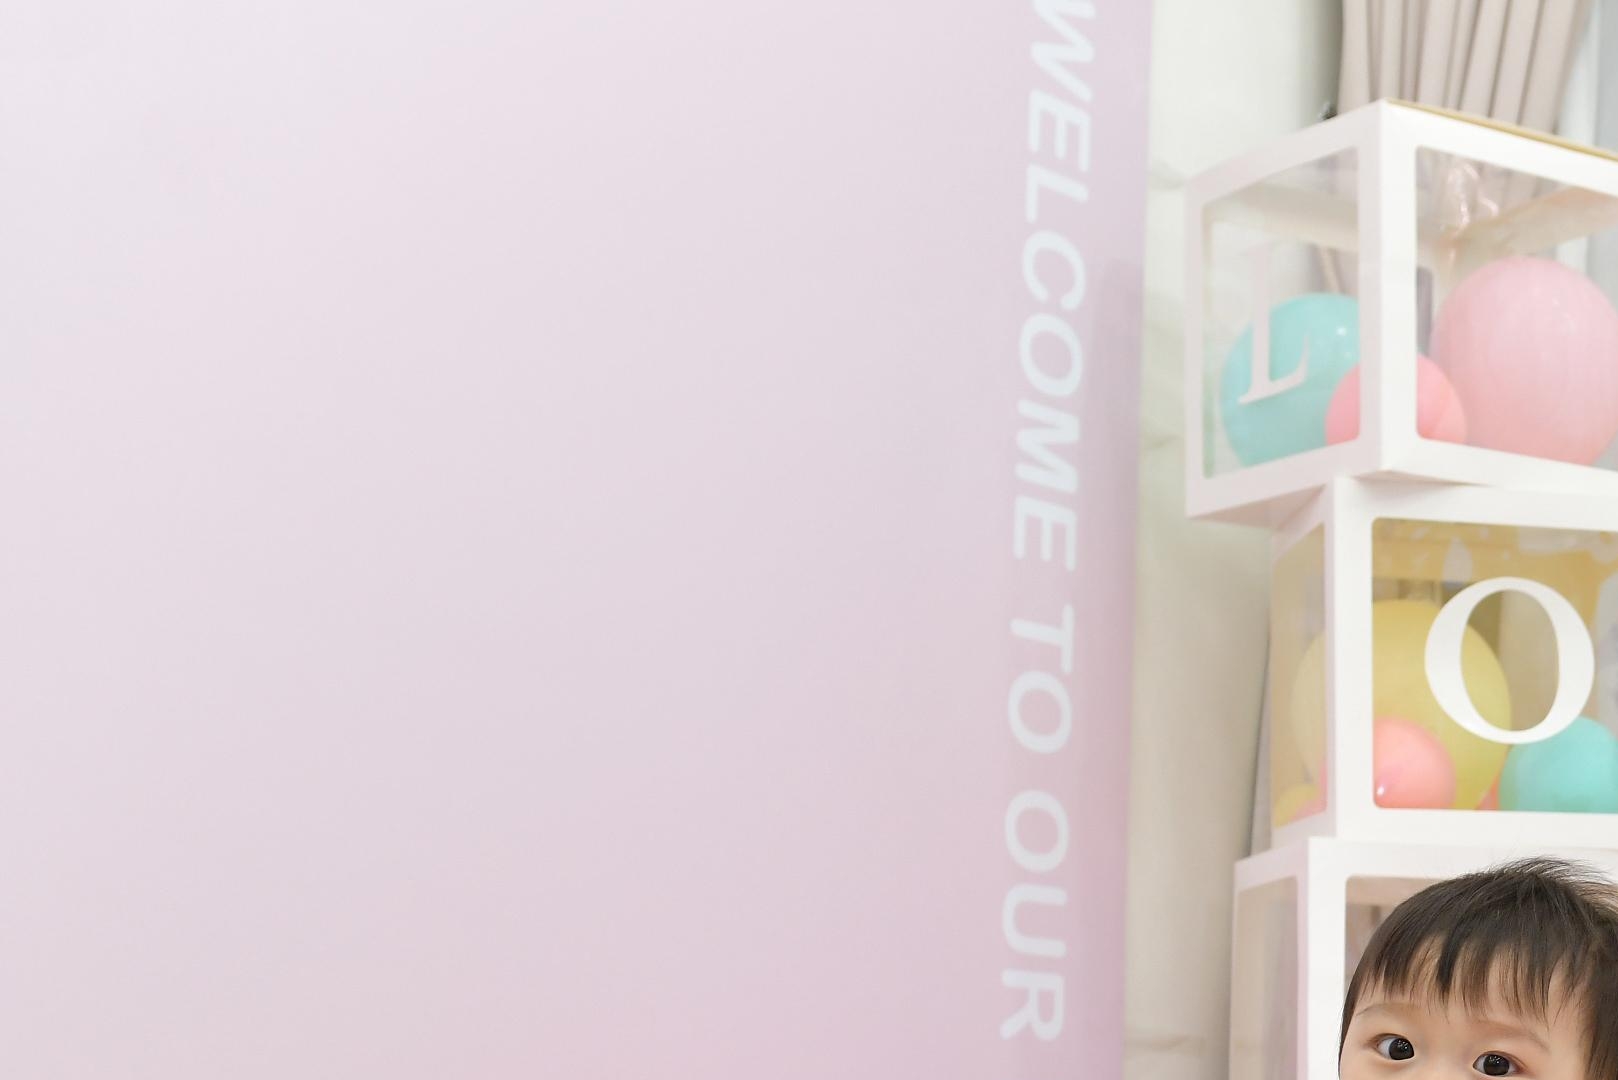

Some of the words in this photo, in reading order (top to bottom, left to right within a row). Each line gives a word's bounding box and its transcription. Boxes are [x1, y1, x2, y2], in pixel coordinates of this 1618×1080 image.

[1012, 0, 1096, 571] WELCOME
[1237, 244, 1309, 404] L
[1007, 603, 1076, 755] TO
[1424, 576, 1595, 744] O
[1001, 789, 1070, 1040] OUR
